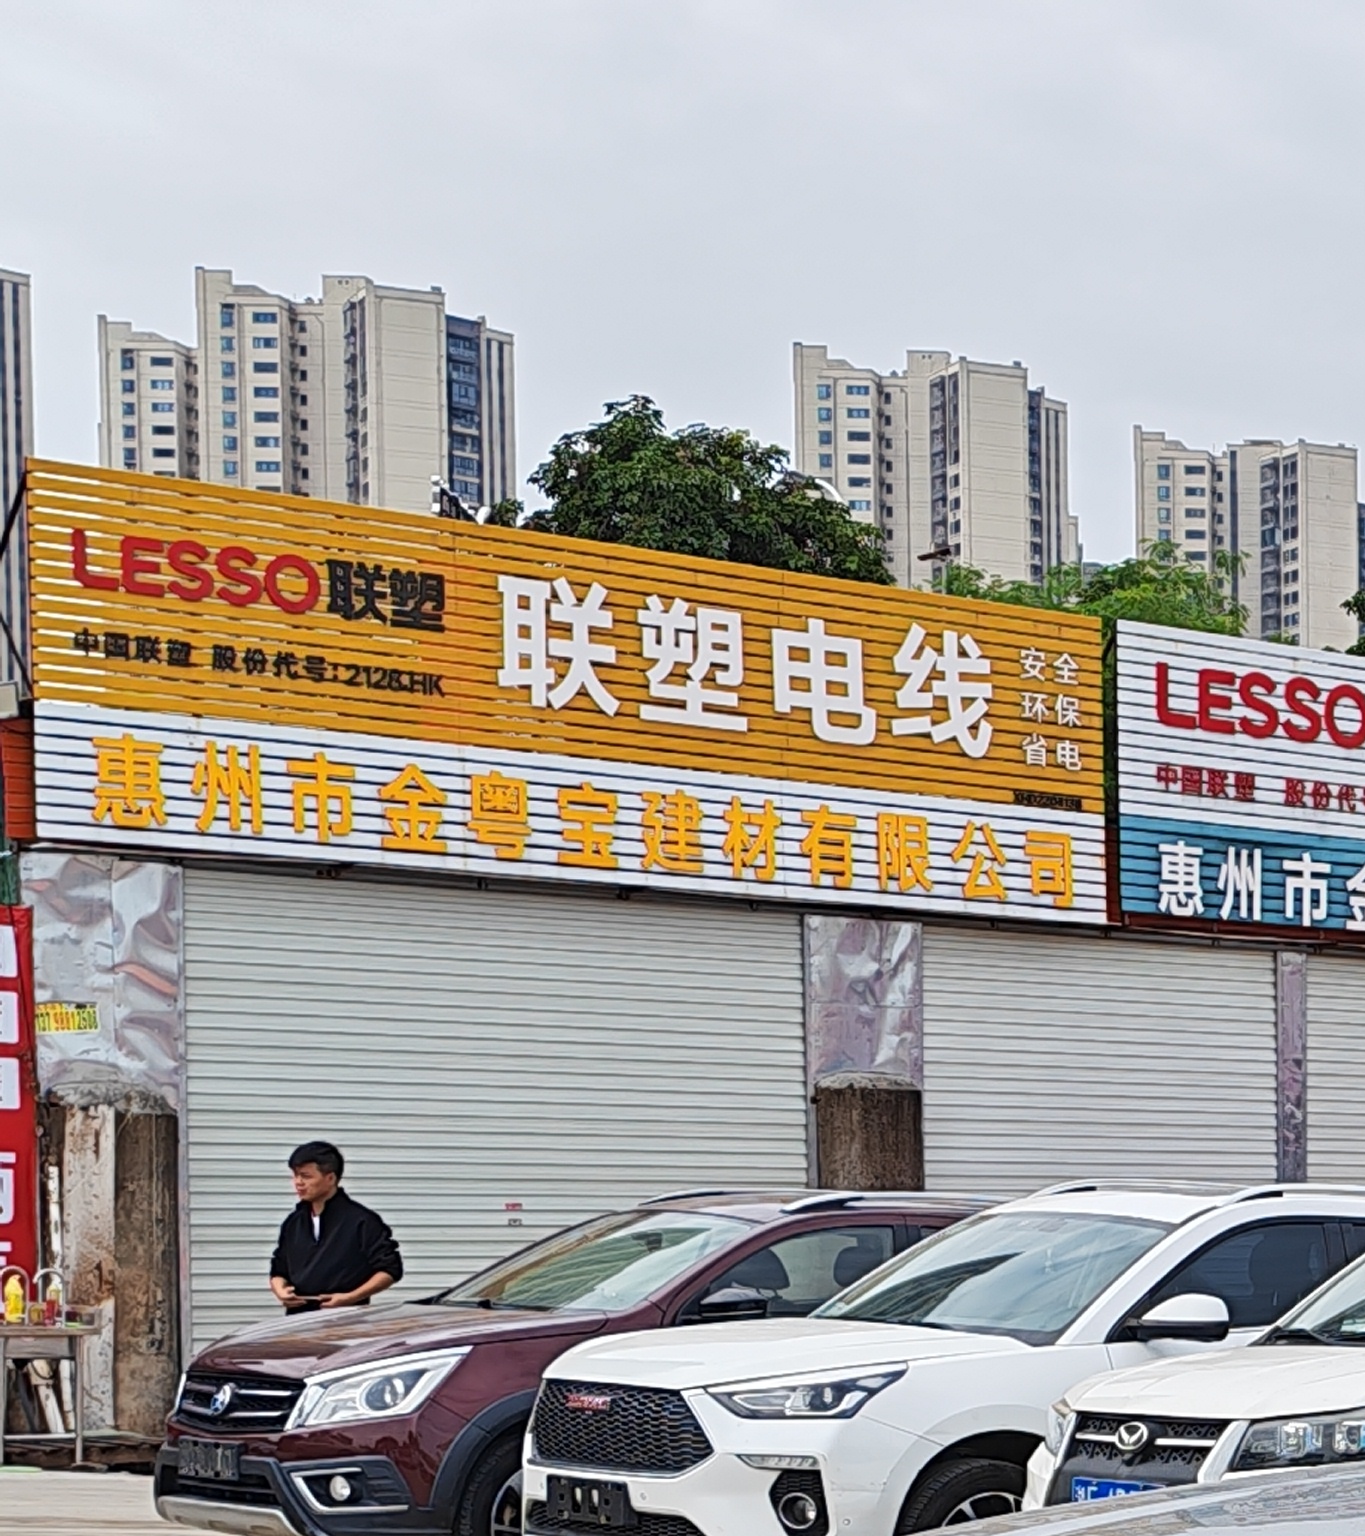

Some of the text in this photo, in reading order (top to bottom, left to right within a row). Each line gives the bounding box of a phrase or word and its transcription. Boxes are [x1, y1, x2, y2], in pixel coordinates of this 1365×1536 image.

[496, 574, 993, 759] 联塑电线
[1019, 647, 1081, 686] 安全
[1020, 692, 1082, 728] 环保
[1021, 731, 1083, 773] 省电
[91, 733, 1075, 909] 惠州市金粤宝建材有限公司
